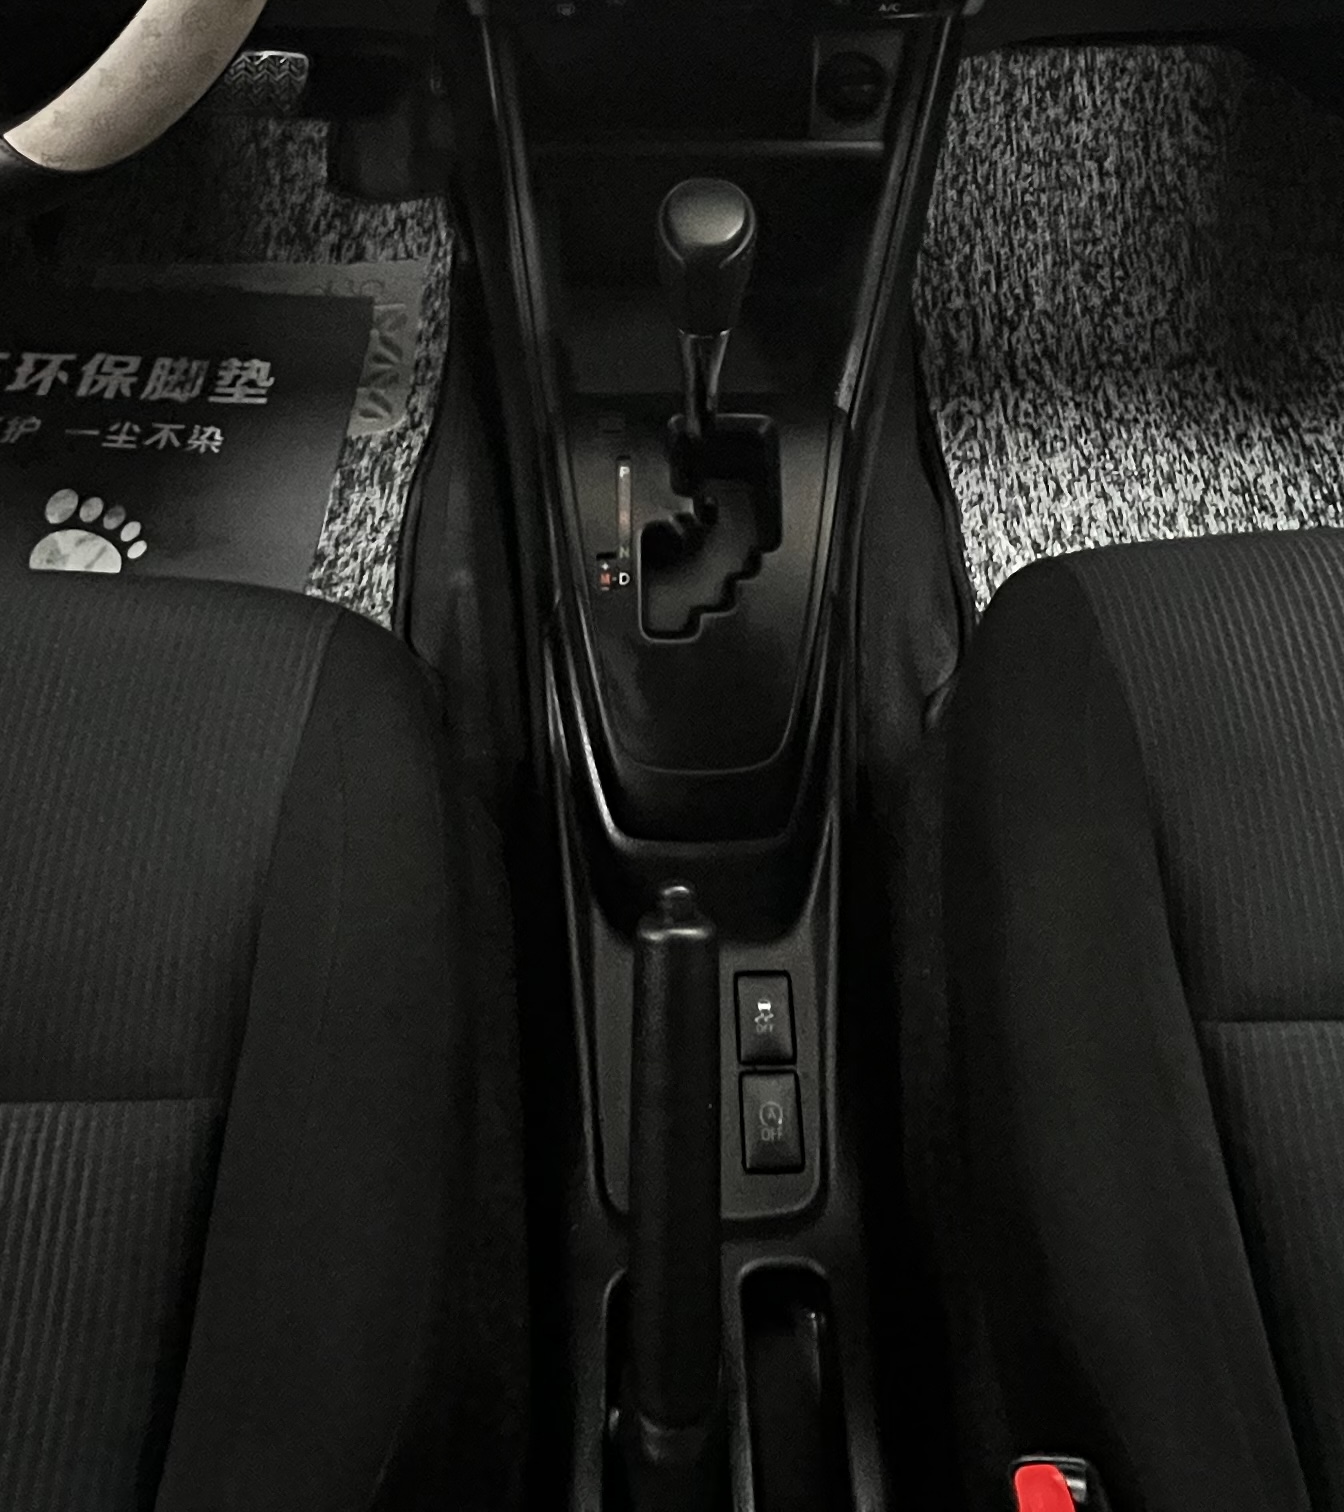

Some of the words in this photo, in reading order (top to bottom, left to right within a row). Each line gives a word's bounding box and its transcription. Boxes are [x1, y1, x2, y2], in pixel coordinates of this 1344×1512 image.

[64, 420, 225, 453] 一尘不染
[618, 465, 631, 479] P
[618, 571, 631, 586] D
